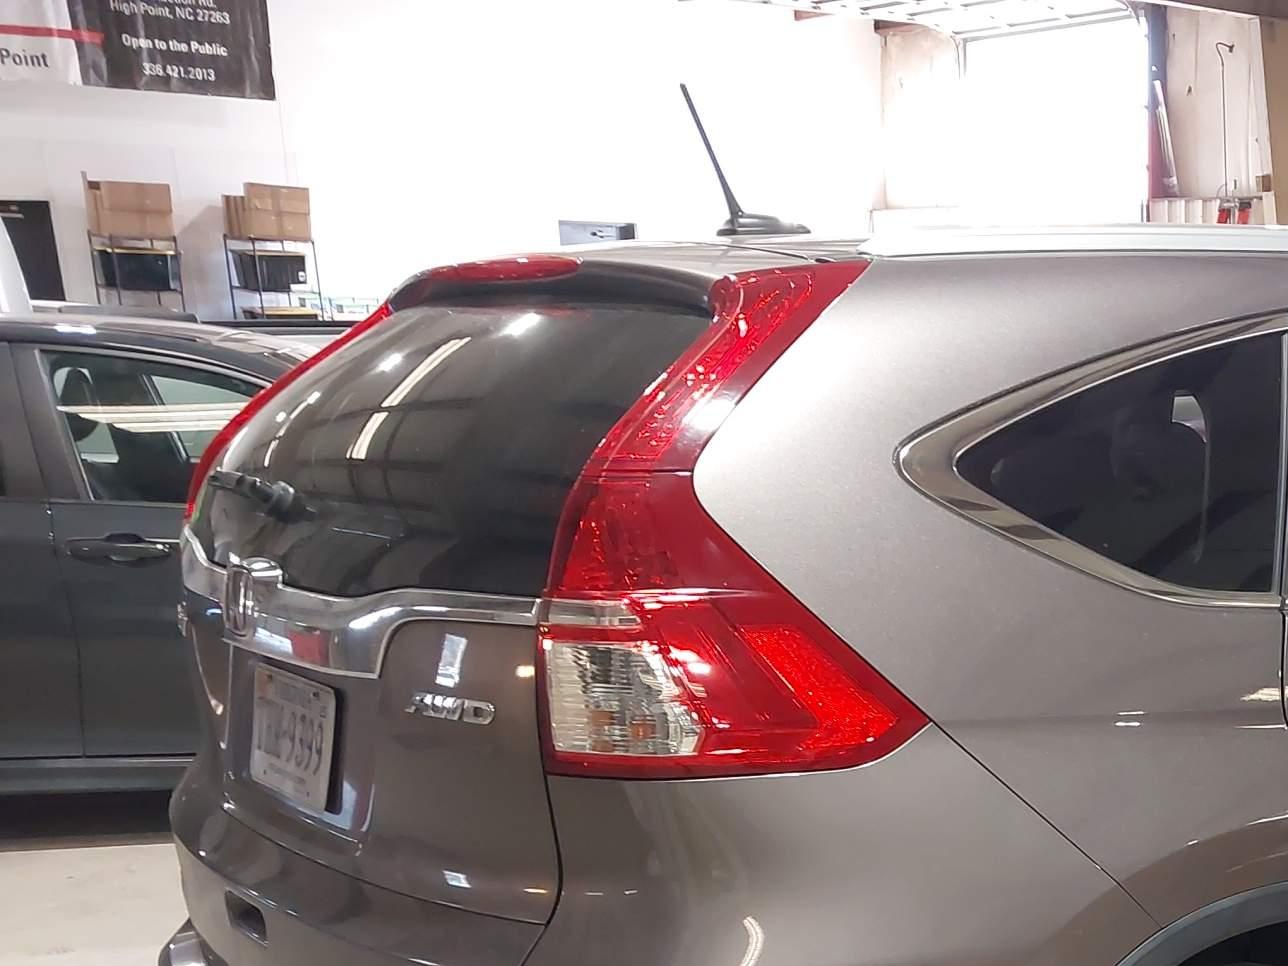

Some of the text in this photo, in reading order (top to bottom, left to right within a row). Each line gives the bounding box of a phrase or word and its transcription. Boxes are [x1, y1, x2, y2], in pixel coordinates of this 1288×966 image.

[109, 0, 138, 16] High
[175, 6, 194, 21] NC
[196, 8, 231, 25] 27263
[121, 33, 228, 56] Open to the Public
[0, 48, 49, 68] Point
[142, 62, 216, 81] 336.421.2013
[404, 691, 496, 725] AWD
